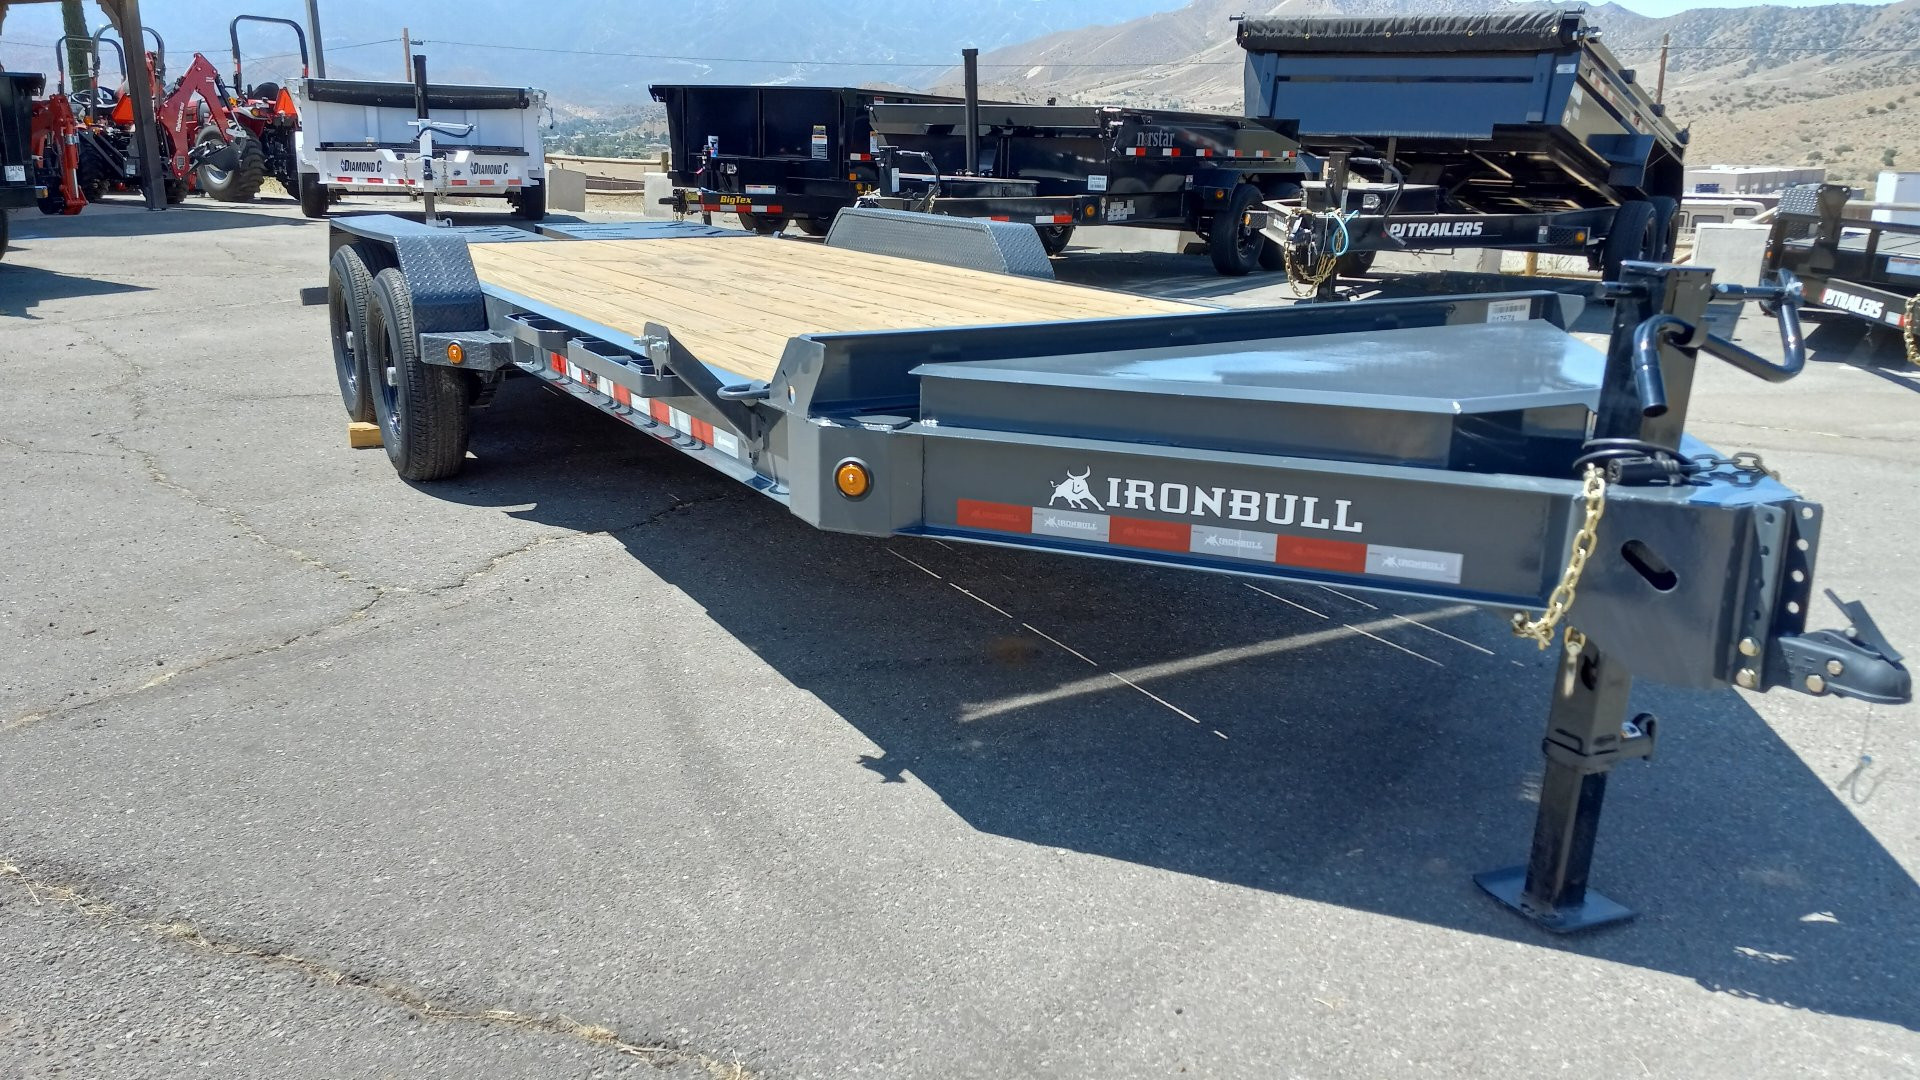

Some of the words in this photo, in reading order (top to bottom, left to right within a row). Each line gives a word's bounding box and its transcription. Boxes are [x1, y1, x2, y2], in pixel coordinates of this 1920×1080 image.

[377, 160, 383, 172] C
[503, 162, 509, 174] C
[720, 196, 752, 204] BigTex
[1389, 223, 1407, 237] PJ
[1408, 222, 1484, 236] TRAILERS
[1833, 290, 1884, 319] TRAILERS
[1106, 477, 1363, 533] IRONBULL
[1057, 519, 1098, 530] IRONBULL
[1218, 537, 1264, 549] IRONBULL
[1399, 559, 1447, 572] IRONBULL
